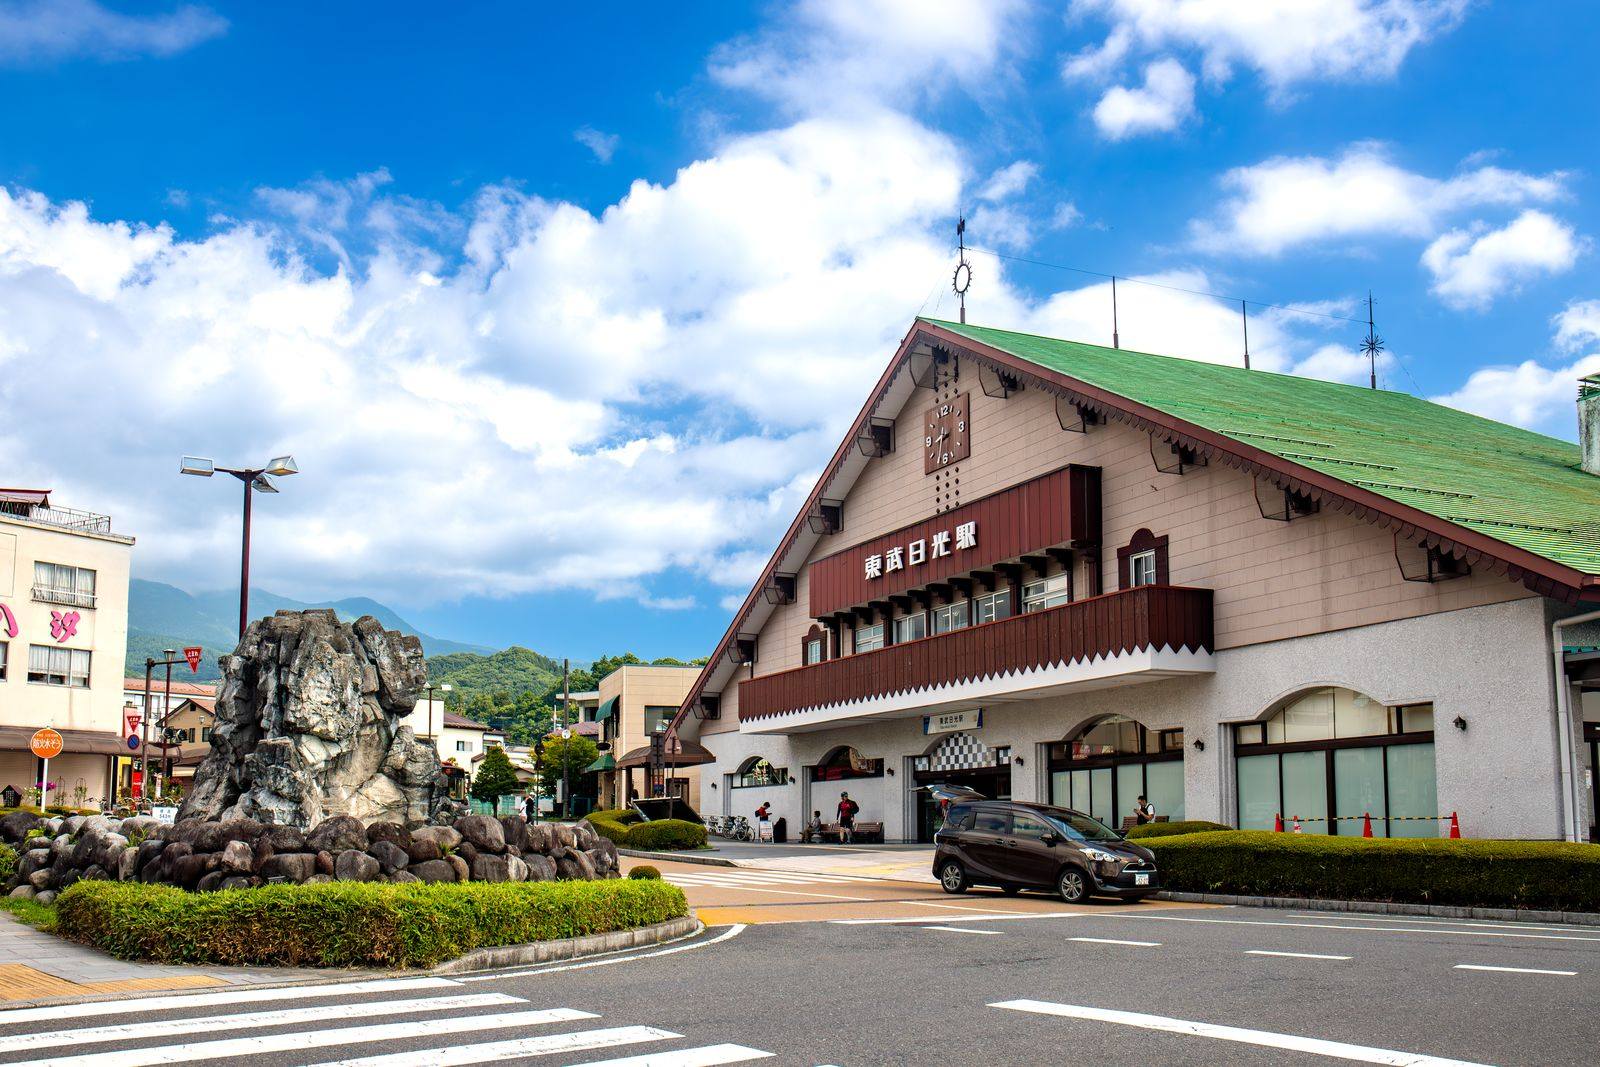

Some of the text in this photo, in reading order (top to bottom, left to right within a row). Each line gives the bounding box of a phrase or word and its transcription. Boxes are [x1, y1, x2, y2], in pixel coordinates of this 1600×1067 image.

[940, 404, 949, 417] 12
[958, 421, 965, 432] 3
[925, 436, 932, 448] 9
[942, 452, 949, 464] 6
[865, 521, 977, 580] 東武日光駅
[32, 737, 62, 749] 防火水そう
